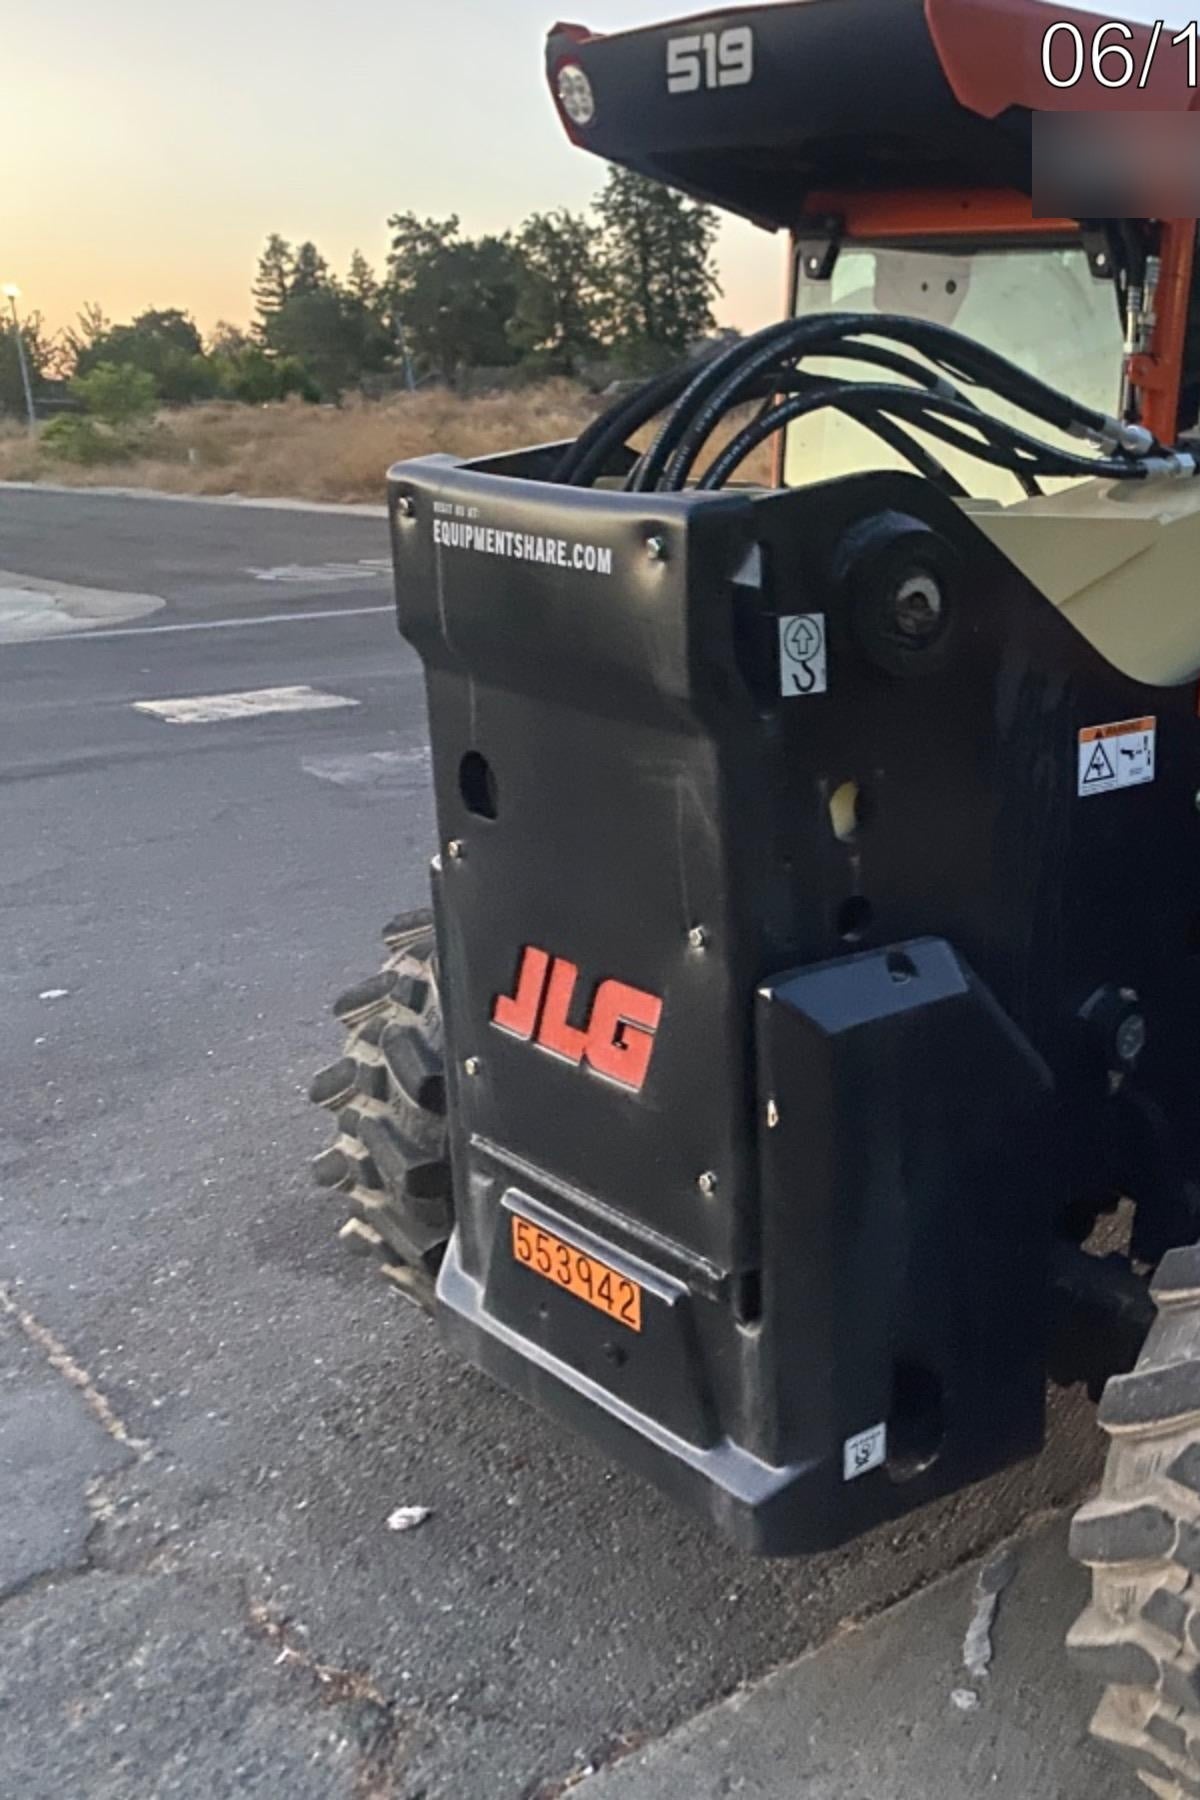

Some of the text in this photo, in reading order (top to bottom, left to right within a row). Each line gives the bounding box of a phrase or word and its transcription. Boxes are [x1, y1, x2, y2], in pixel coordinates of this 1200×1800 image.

[666, 26, 753, 93] 519
[432, 519, 613, 575] EQUIPMENTSHARE.COM
[491, 944, 663, 1092] JLG
[515, 1221, 637, 1324] 553942
